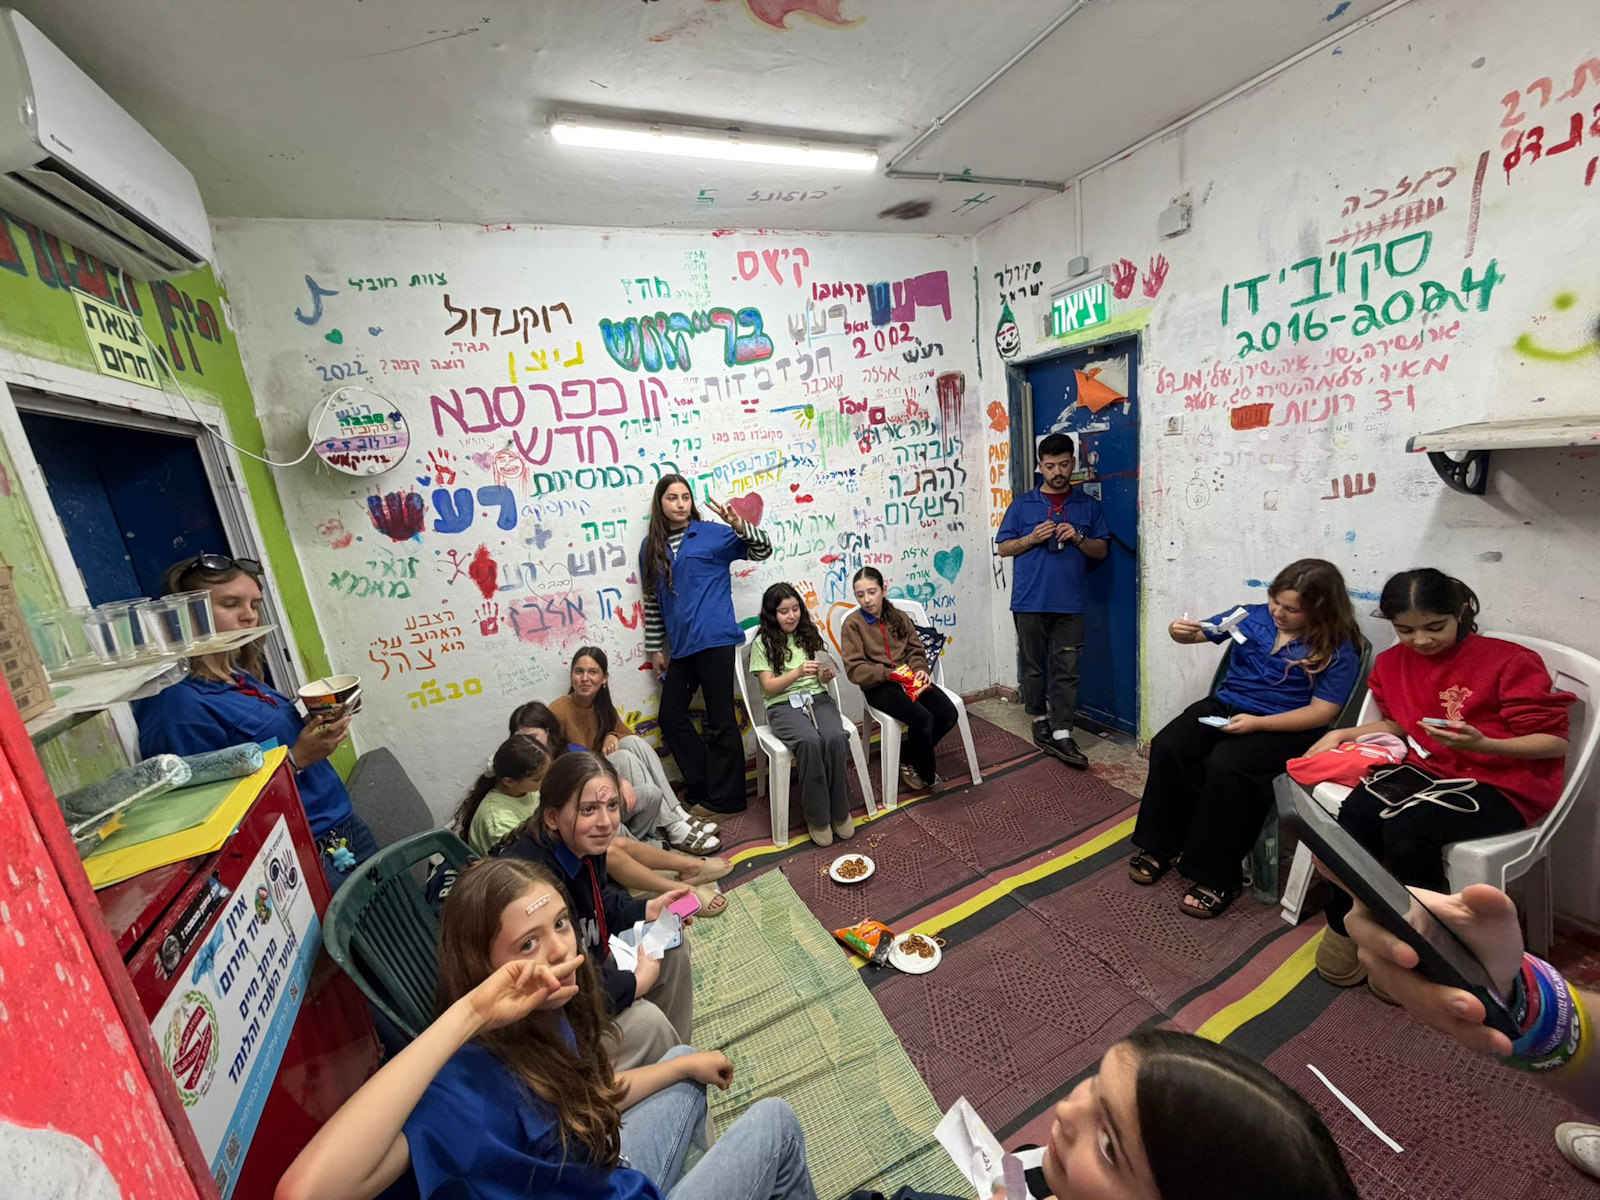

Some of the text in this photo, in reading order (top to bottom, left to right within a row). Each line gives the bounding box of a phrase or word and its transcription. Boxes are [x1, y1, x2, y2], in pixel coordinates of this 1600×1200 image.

[408, 272, 448, 287] צוות
[444, 293, 572, 344] רוקנרול
[1053, 284, 1105, 335] יציאה
[852, 322, 916, 360] 2002
[99, 342, 154, 382] חרום
[316, 360, 368, 382] 2022
[670, 409, 701, 427] רוצה
[512, 425, 620, 467] חדש
[888, 458, 968, 499] להגנה
[990, 463, 1006, 485] OF
[580, 518, 628, 542] קפה
[404, 610, 455, 631] הצבע
[408, 626, 462, 645] האהוב
[440, 641, 466, 654] הוא
[224, 894, 250, 939] ארון
[217, 935, 250, 997] חירום
[237, 936, 278, 1022] מרחב חיים
[227, 1013, 261, 1090] והלומד
